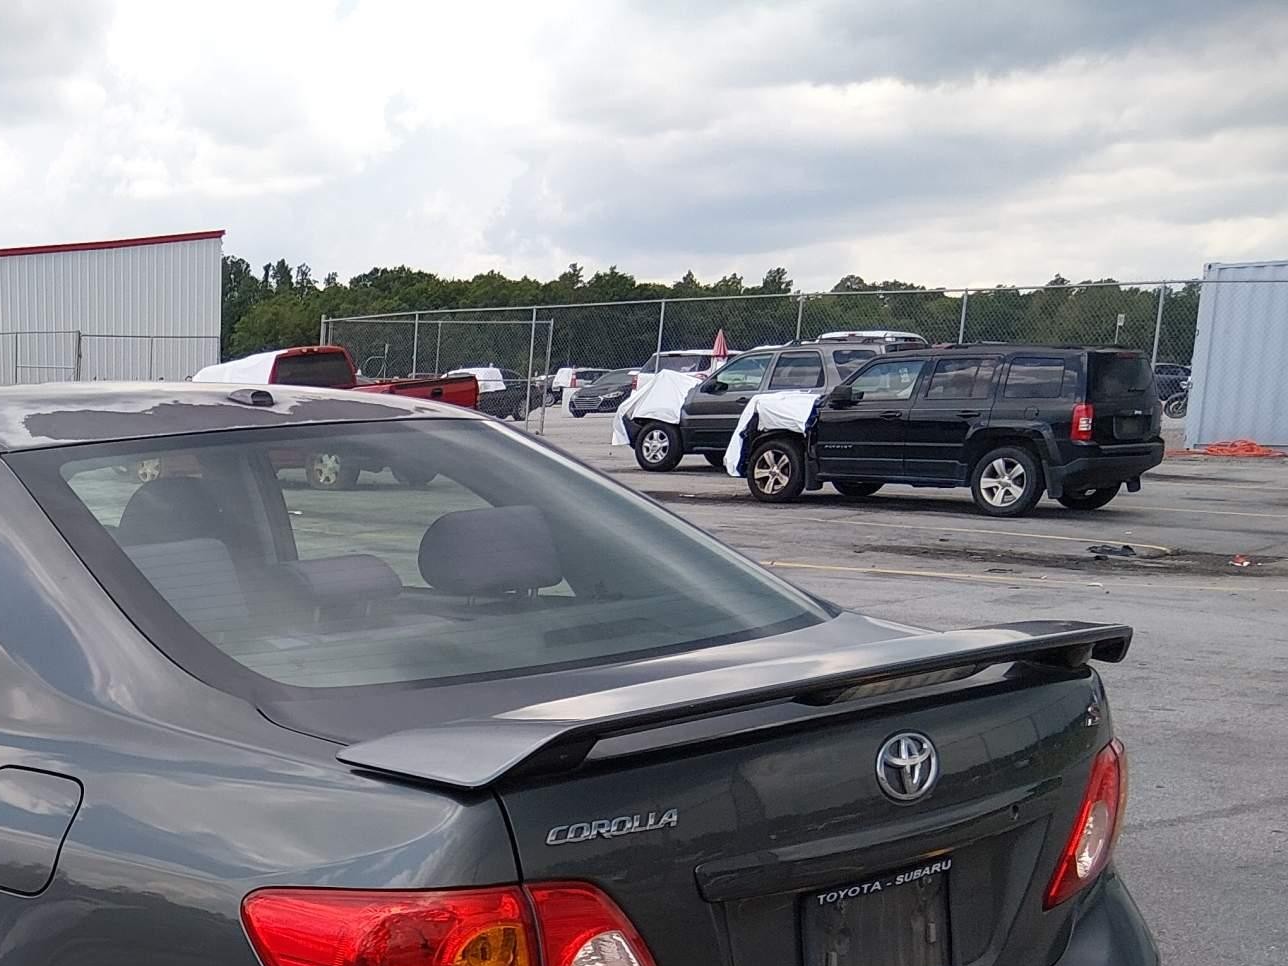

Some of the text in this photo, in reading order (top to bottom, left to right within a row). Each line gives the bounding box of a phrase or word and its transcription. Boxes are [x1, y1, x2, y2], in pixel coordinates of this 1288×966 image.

[546, 808, 678, 845] COROLLA
[817, 881, 882, 905] TOYOTA
[895, 859, 952, 885] SUBARU
